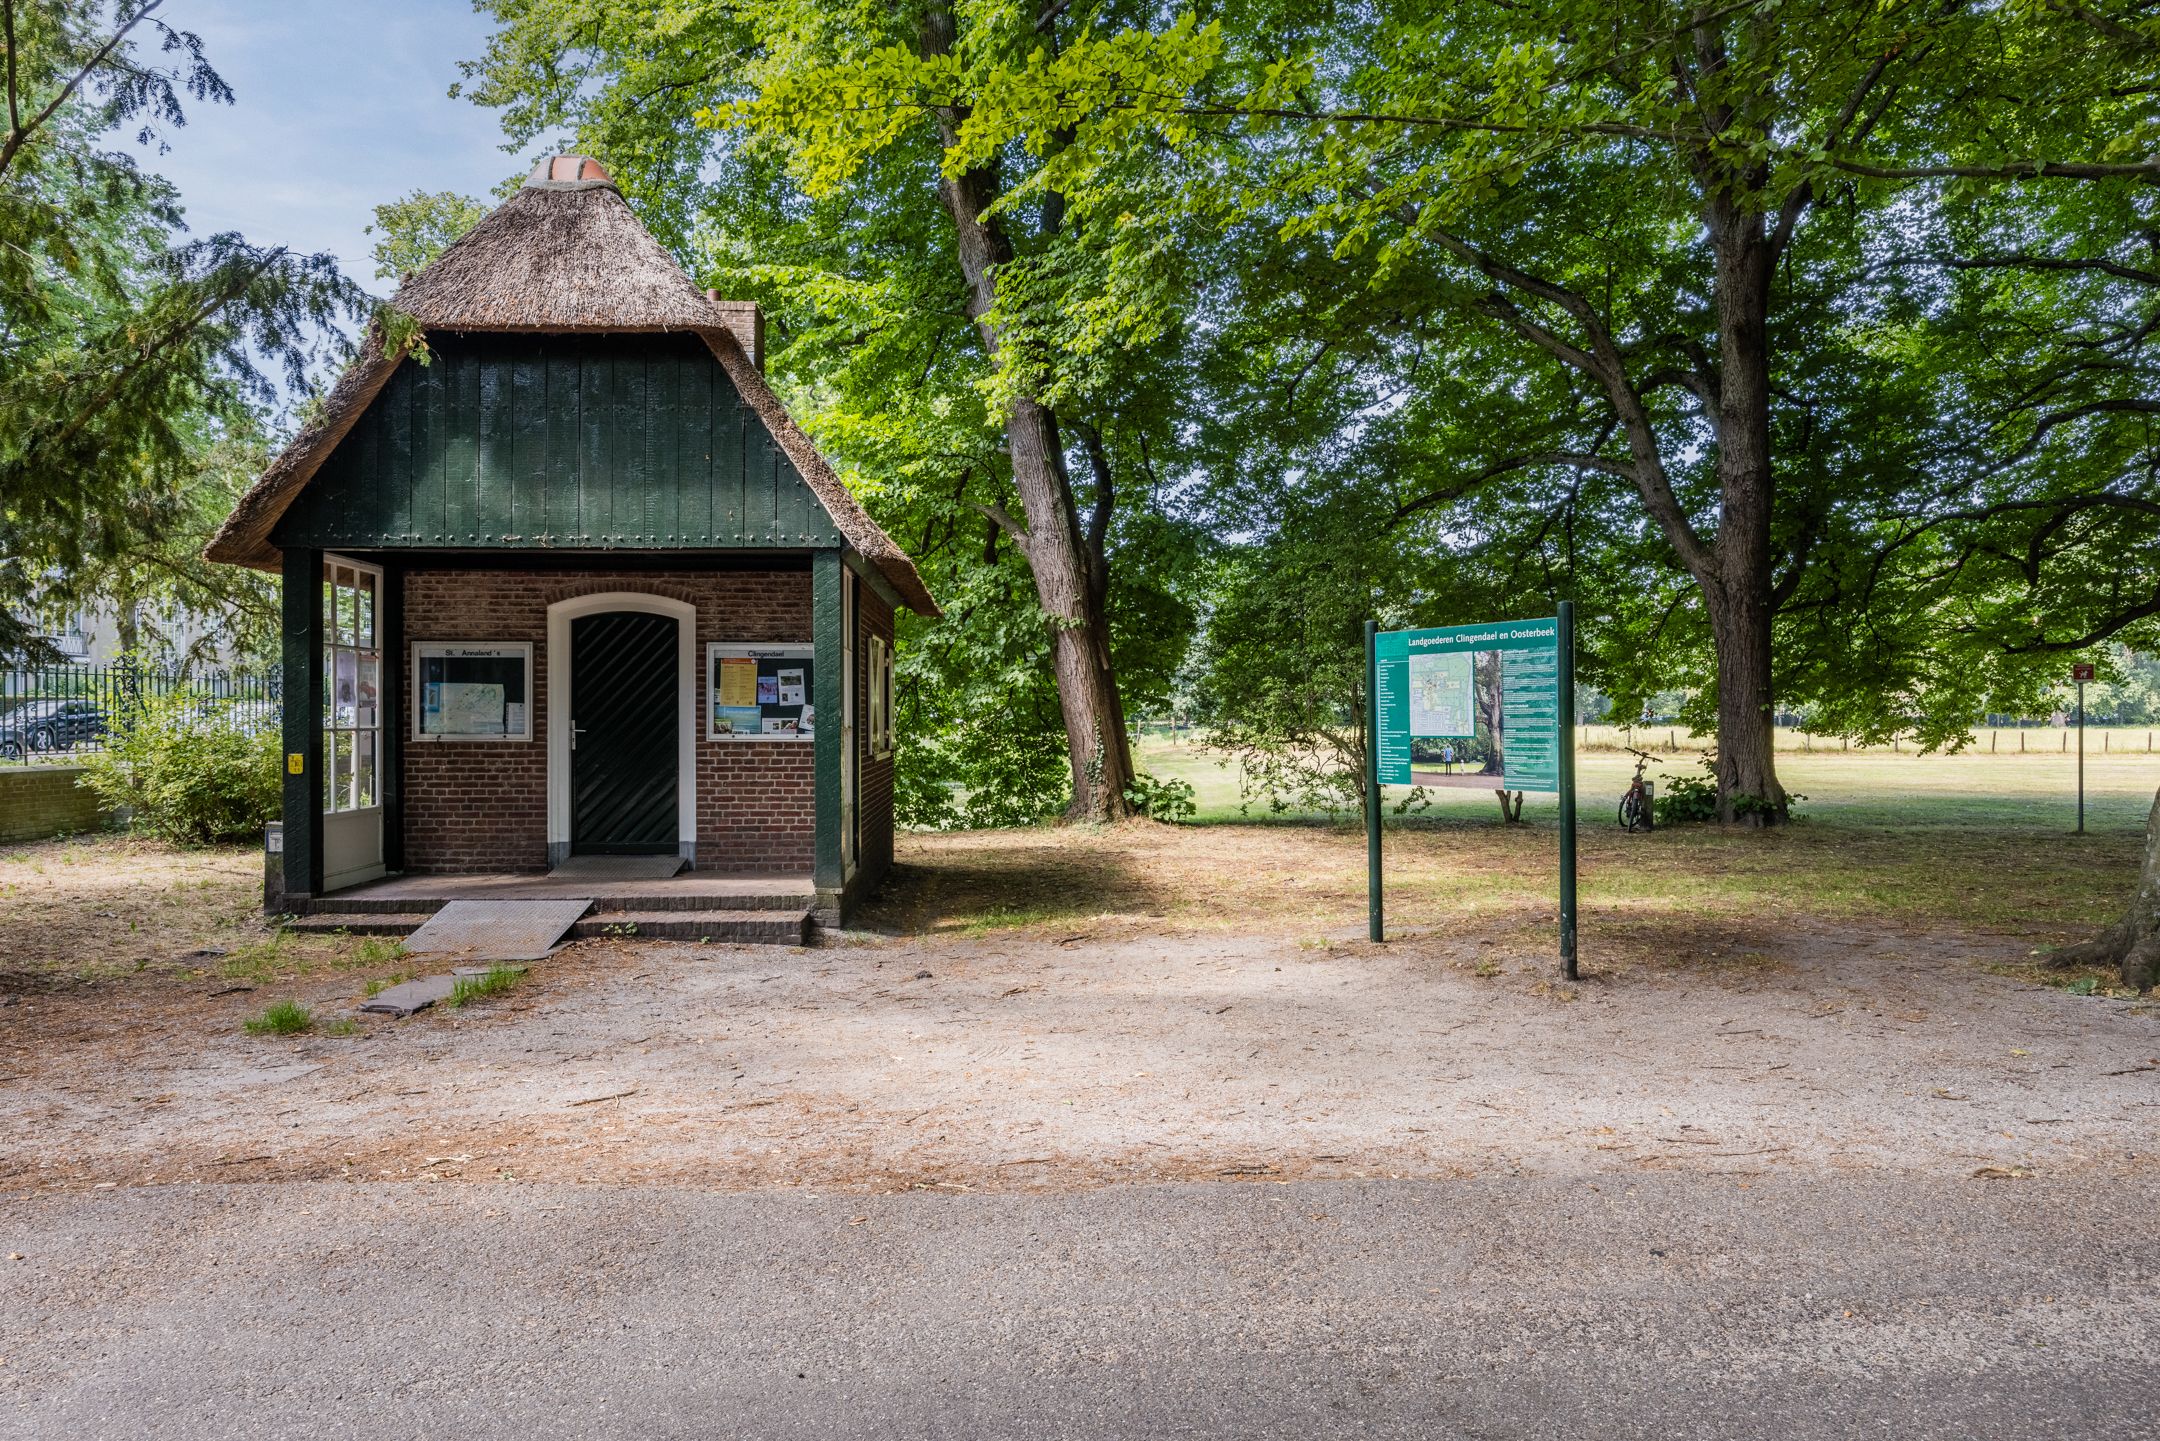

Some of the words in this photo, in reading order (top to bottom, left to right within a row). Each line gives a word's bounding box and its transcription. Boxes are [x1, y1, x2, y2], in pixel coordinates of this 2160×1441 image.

[1408, 636, 1453, 647] Landgoederen
[1456, 632, 1497, 644] Clingendael
[1511, 627, 1554, 638] Oosterbeek
